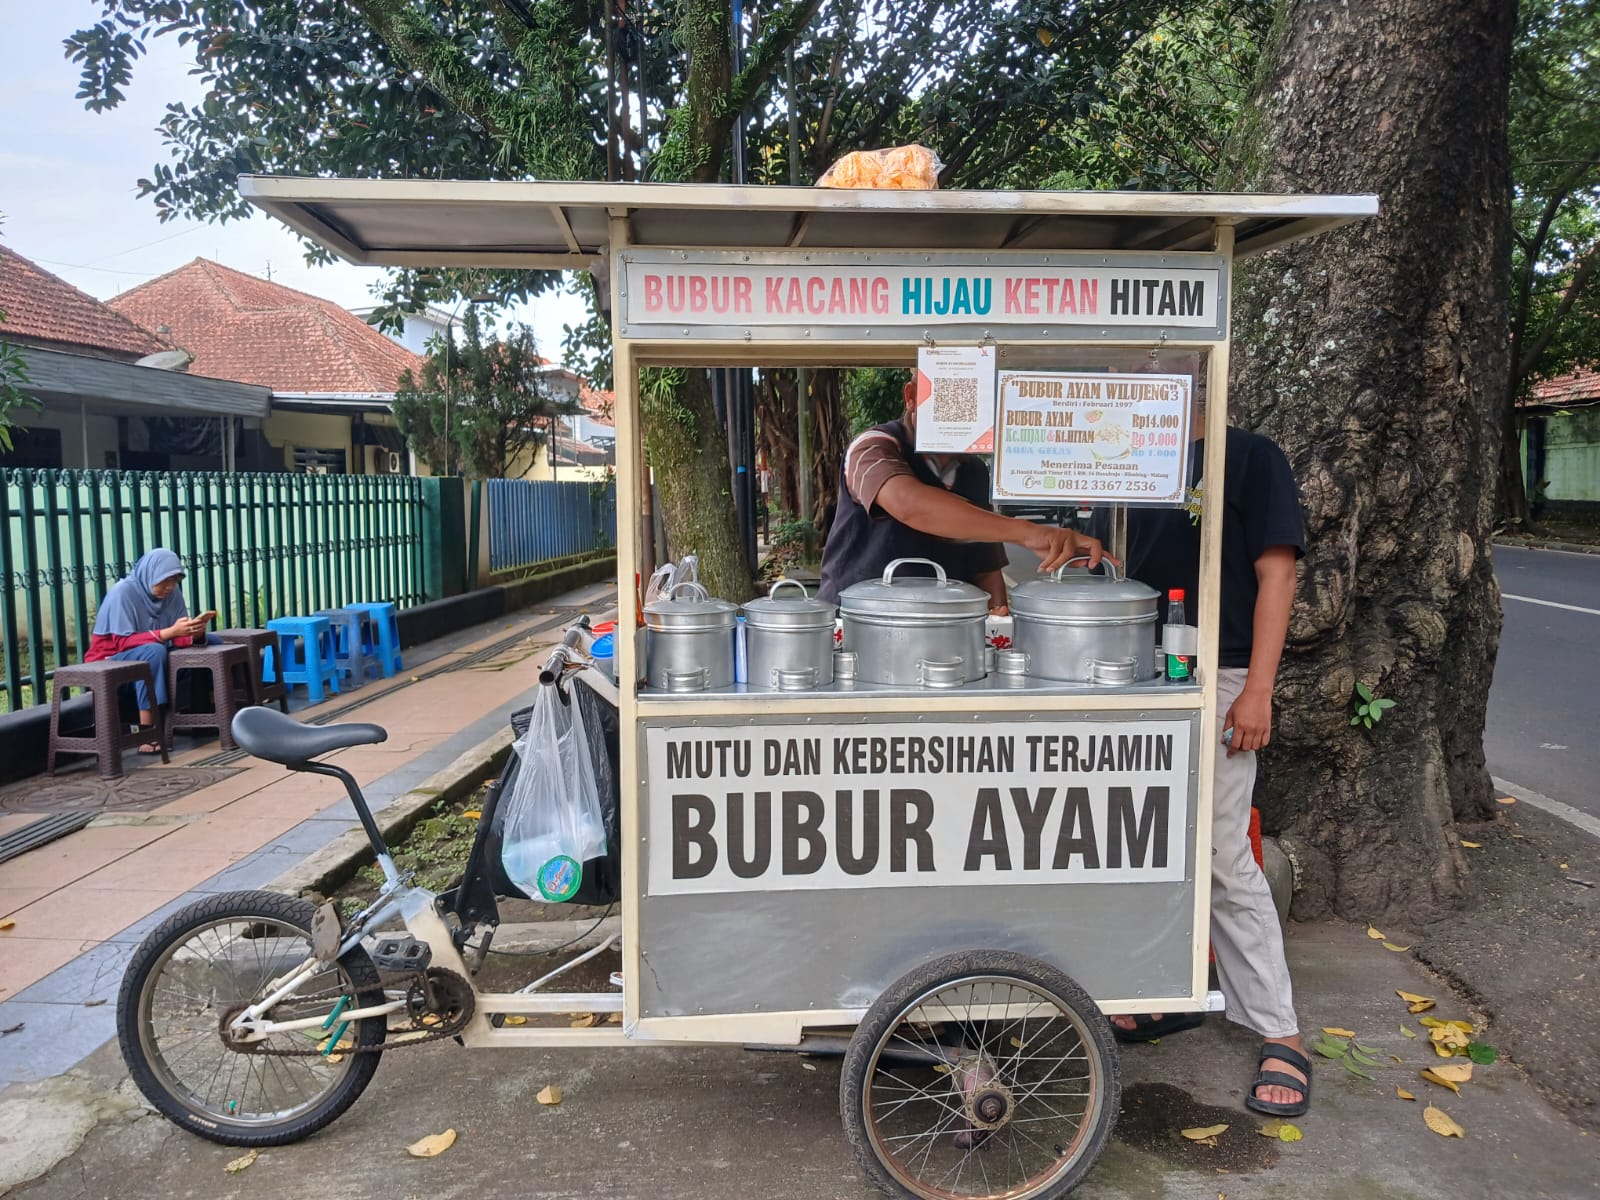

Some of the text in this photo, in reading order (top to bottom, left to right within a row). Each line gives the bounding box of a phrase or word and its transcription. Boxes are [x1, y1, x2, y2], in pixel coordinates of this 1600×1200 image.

[644, 274, 1205, 317] BUBUR KACANG HIJAU KETAN HITAM
[1066, 382, 1101, 399] AYAM
[1170, 390, 1179, 401] 3
[1006, 410, 1074, 427] BUBUR AYAM
[1131, 413, 1179, 429] Rp14.000
[1131, 431, 1178, 448] Rp 9.000
[1040, 460, 1139, 470] Menerima Pesanan
[1058, 479, 1157, 491] 0812 3367 2536
[666, 733, 1173, 779] MUTU DAN KEBERSIHAN TERJAMIN
[671, 785, 1171, 880] BUBUR AYAM
